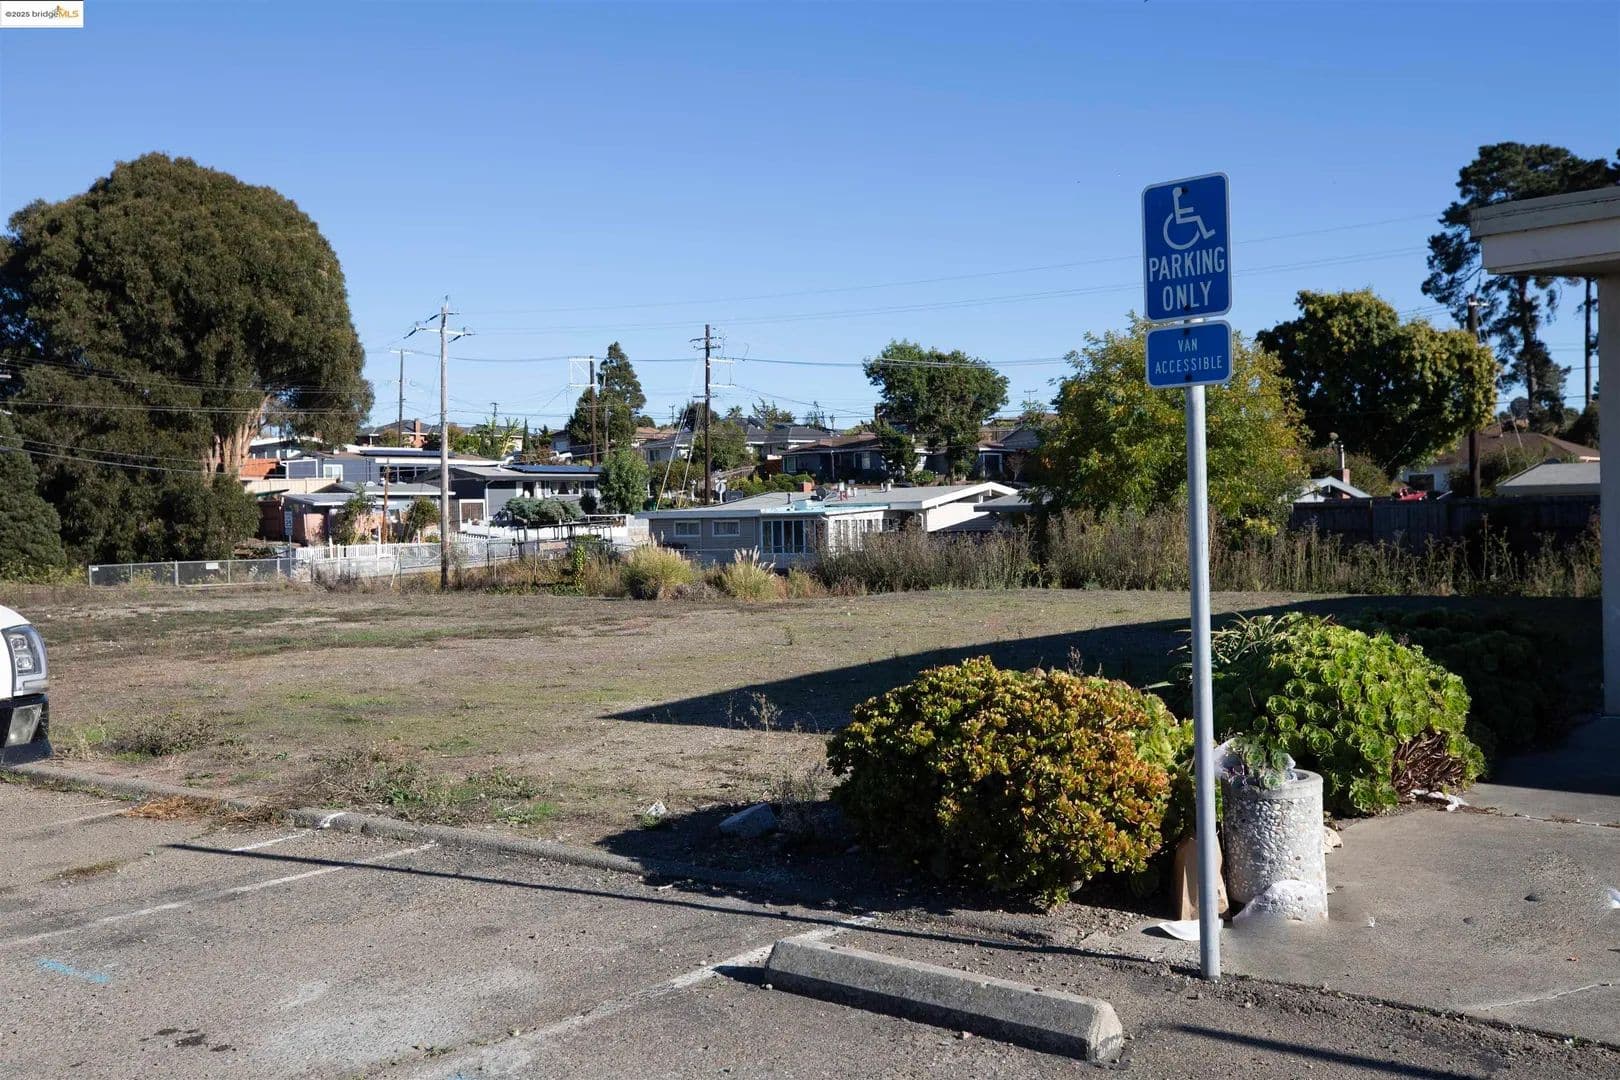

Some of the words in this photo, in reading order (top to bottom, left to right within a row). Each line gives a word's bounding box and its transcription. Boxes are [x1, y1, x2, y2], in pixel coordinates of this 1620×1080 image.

[1149, 247, 1225, 282] PARKING
[1163, 281, 1212, 311] ONLY
[1178, 338, 1198, 352] VAN
[1155, 356, 1222, 374] ACCESSIBLE
